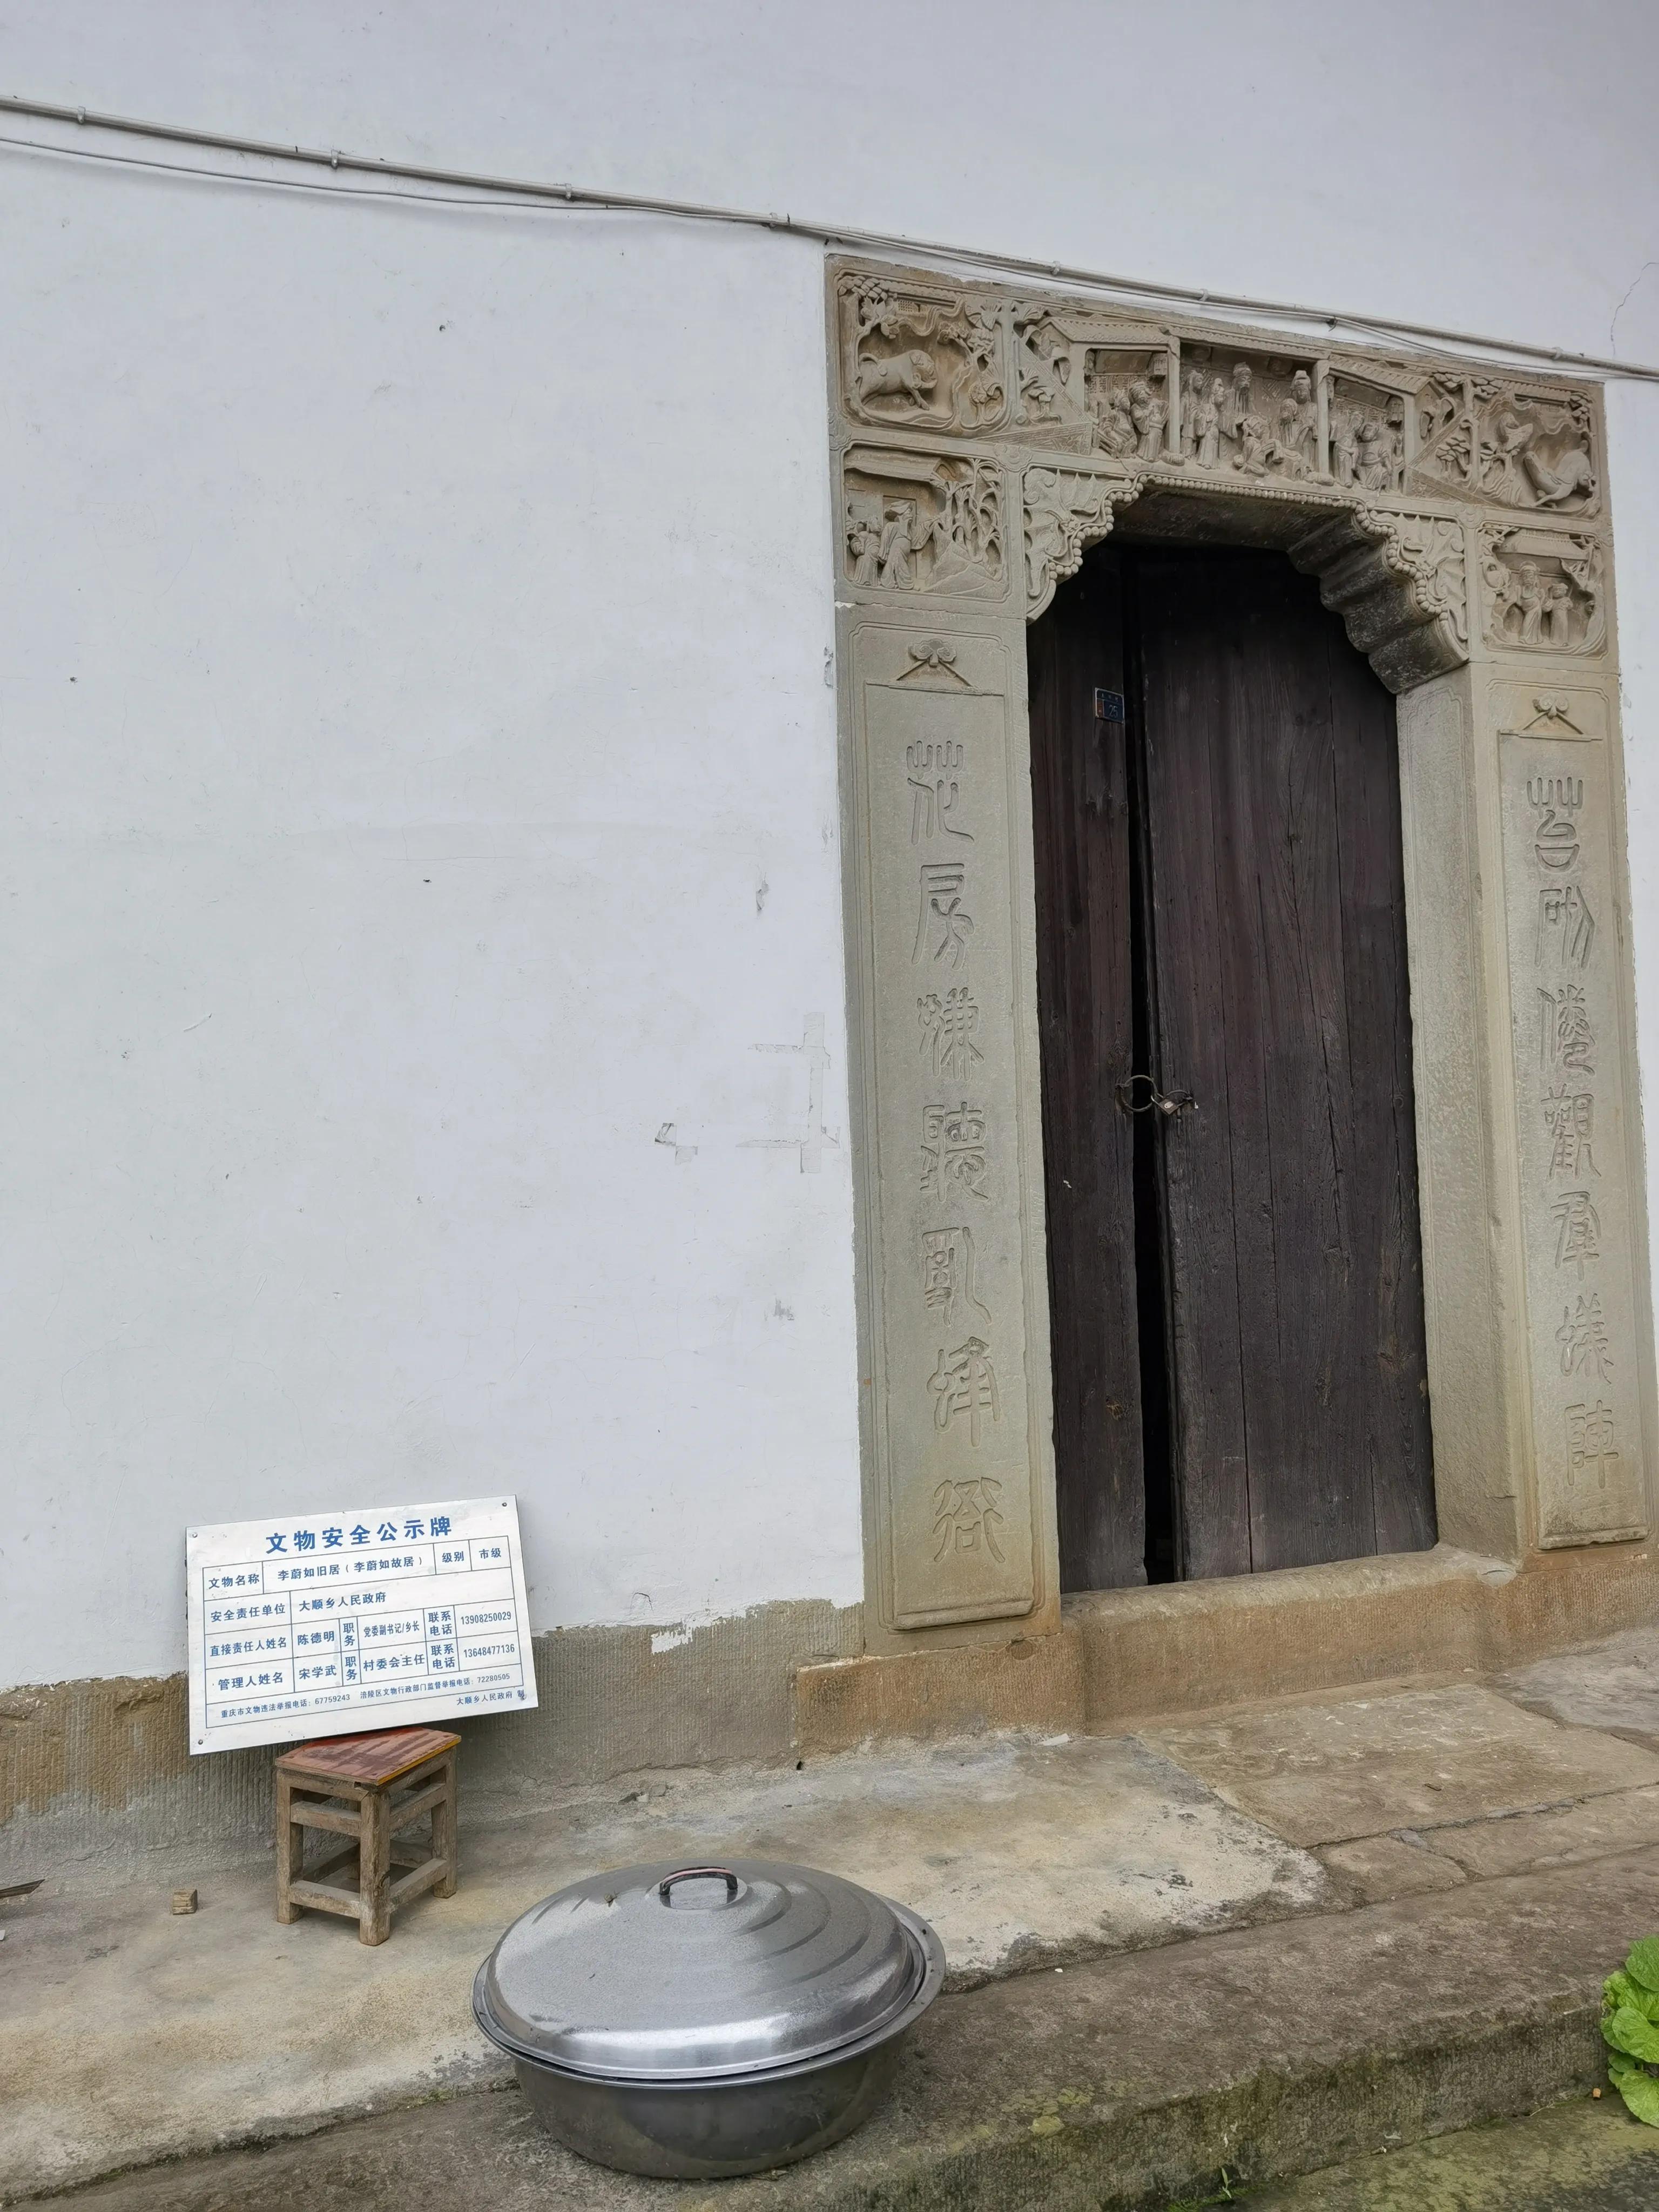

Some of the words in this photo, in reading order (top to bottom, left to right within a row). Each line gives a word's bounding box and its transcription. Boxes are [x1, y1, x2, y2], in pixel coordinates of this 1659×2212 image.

[266, 1516, 452, 1554] 文物安全公示牌
[442, 1552, 464, 1563] 级别
[479, 1547, 501, 1559] 市级
[208, 1574, 260, 1589] 文物名称
[299, 1592, 386, 1611] 大顺乡人民政府
[210, 1603, 286, 1622] 安全责任单位
[461, 1611, 511, 1624] 13908250029
[363, 1620, 420, 1637] 党委副书记/乡长
[298, 1630, 334, 1645] 陈德明
[210, 1637, 287, 1656] 直接责任人姓名
[463, 1644, 515, 1658] 13648477136
[363, 1654, 425, 1671] 村委会主任
[299, 1664, 336, 1680] 宋学武
[218, 1672, 283, 1691] 管理人姓名
